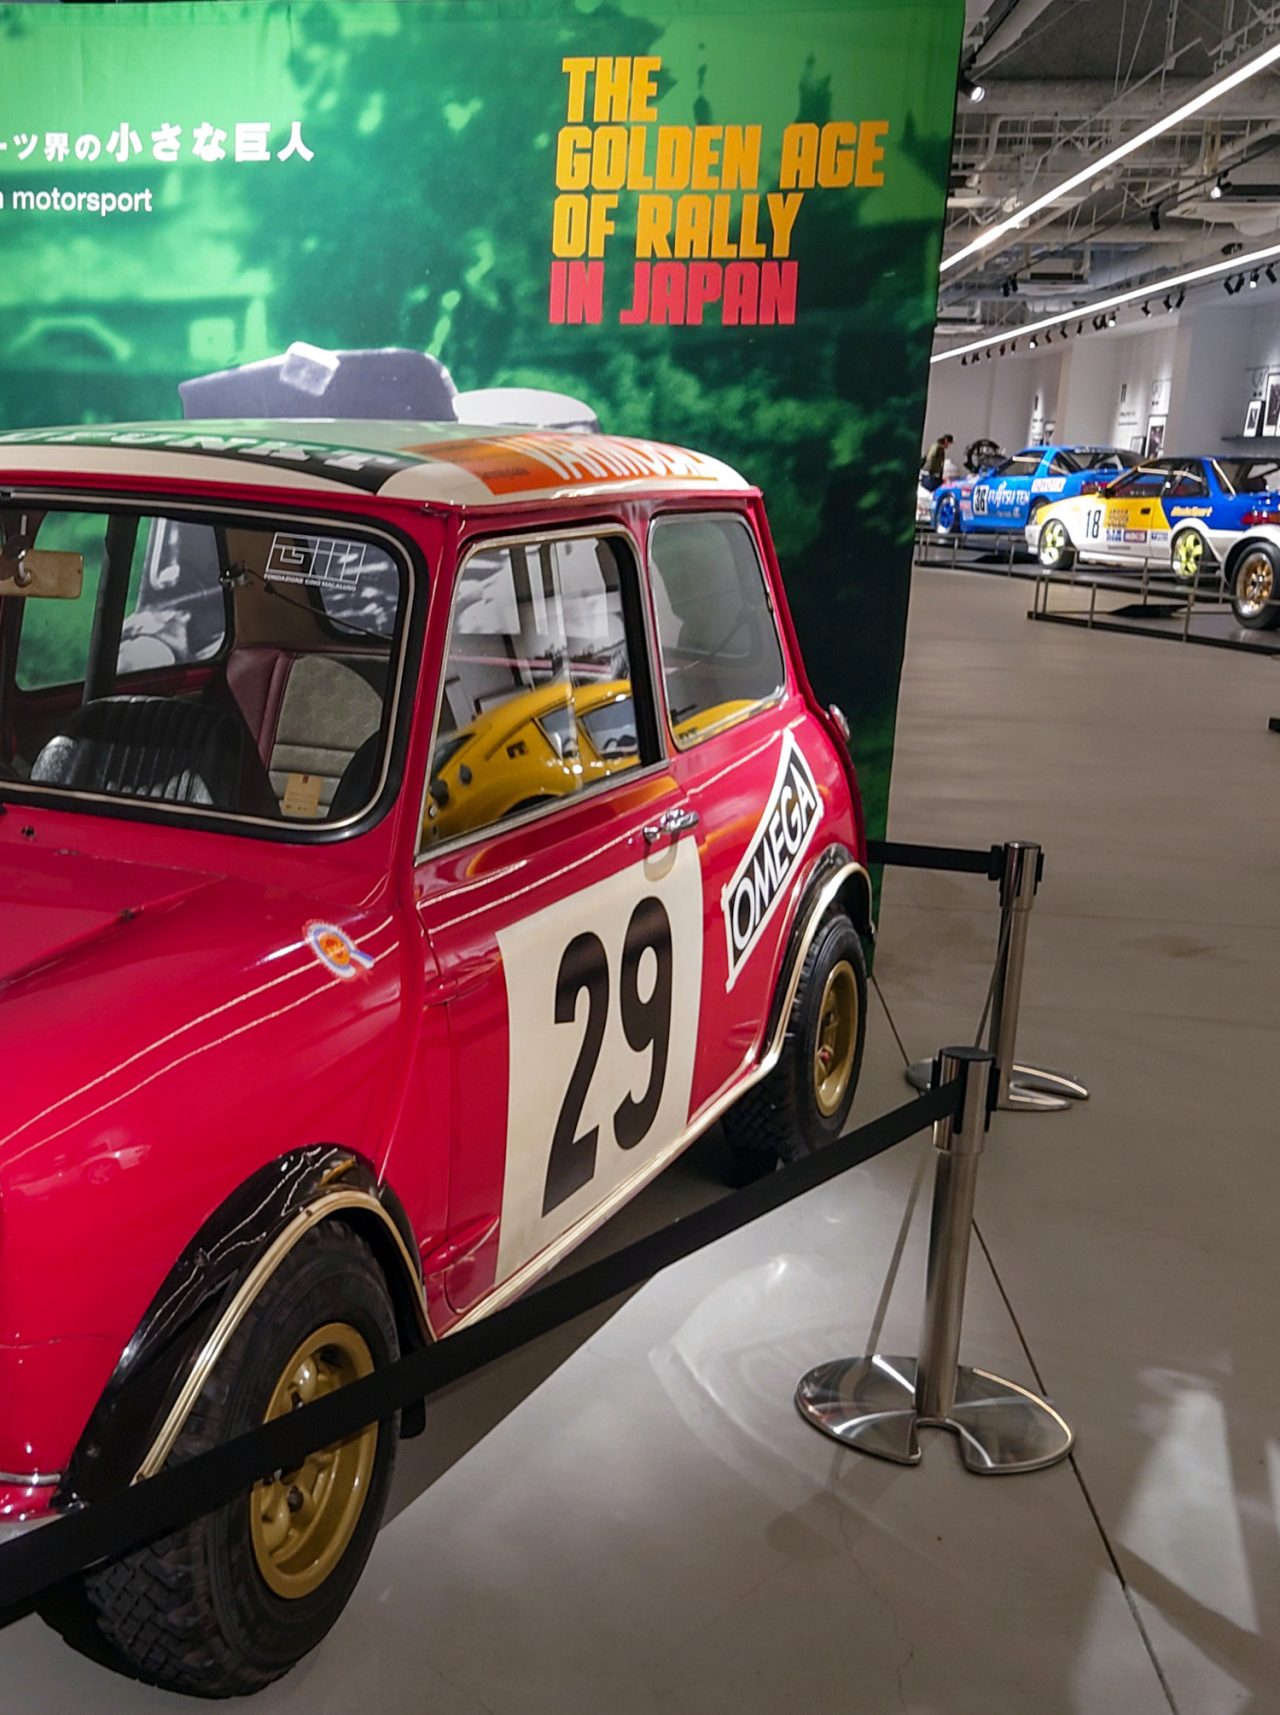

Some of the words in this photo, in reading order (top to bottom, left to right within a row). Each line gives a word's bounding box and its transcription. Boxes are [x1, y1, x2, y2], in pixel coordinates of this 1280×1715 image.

[562, 56, 662, 123] THE
[555, 124, 762, 191] GOLDEN
[779, 120, 889, 188] AGE
[13, 187, 152, 217] motorsport
[552, 193, 619, 259] OF
[635, 192, 805, 259] RALLY
[549, 260, 605, 325] IN
[620, 260, 798, 325] JAPAN
[1086, 509, 1101, 538] 18
[732, 766, 817, 951] OMEGA
[541, 896, 673, 1218] 29
